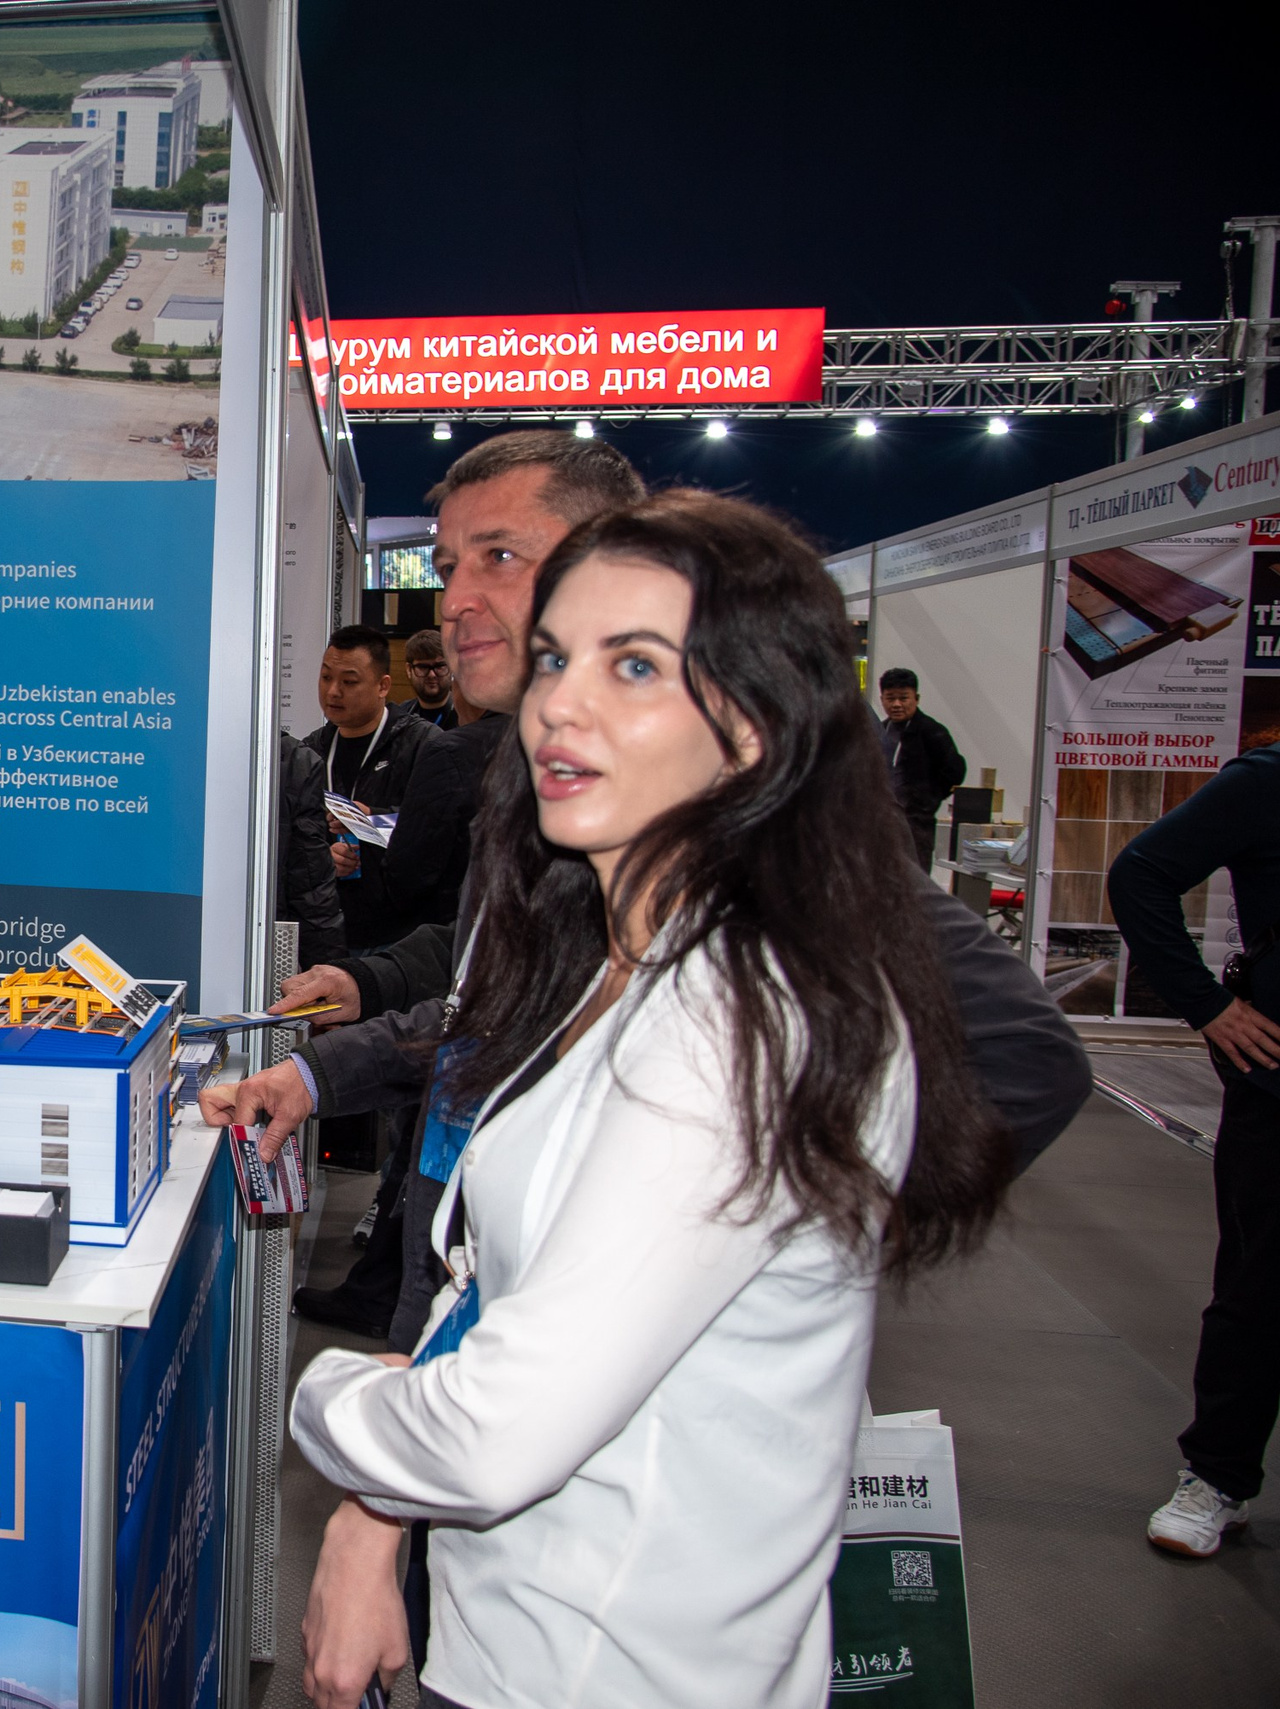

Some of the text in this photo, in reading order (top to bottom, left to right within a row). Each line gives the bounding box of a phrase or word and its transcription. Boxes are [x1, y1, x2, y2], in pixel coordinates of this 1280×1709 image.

[423, 326, 598, 358] китайской
[610, 323, 744, 354] мебели
[757, 329, 778, 351] и
[338, 365, 770, 400] ойматериалов для дома
[1214, 455, 1280, 493] Century
[1131, 481, 1176, 513] ПАРКЕТ
[55, 596, 155, 611] компании
[102, 687, 176, 706] enables
[60, 710, 128, 729] Central
[133, 712, 173, 730] Asia
[1062, 731, 1215, 748] БОЛЬШОЙ ВЫБОР
[7, 748, 18, 761] в
[22, 744, 145, 765] Узбекистане
[1054, 751, 1220, 769] ЦВЕТОВОЙ ГАММЫ
[75, 798, 99, 812] по
[104, 796, 149, 814] всей
[863, 1500, 879, 1509] He
[883, 1498, 908, 1508] Jian
[912, 1499, 932, 1509] Cai
